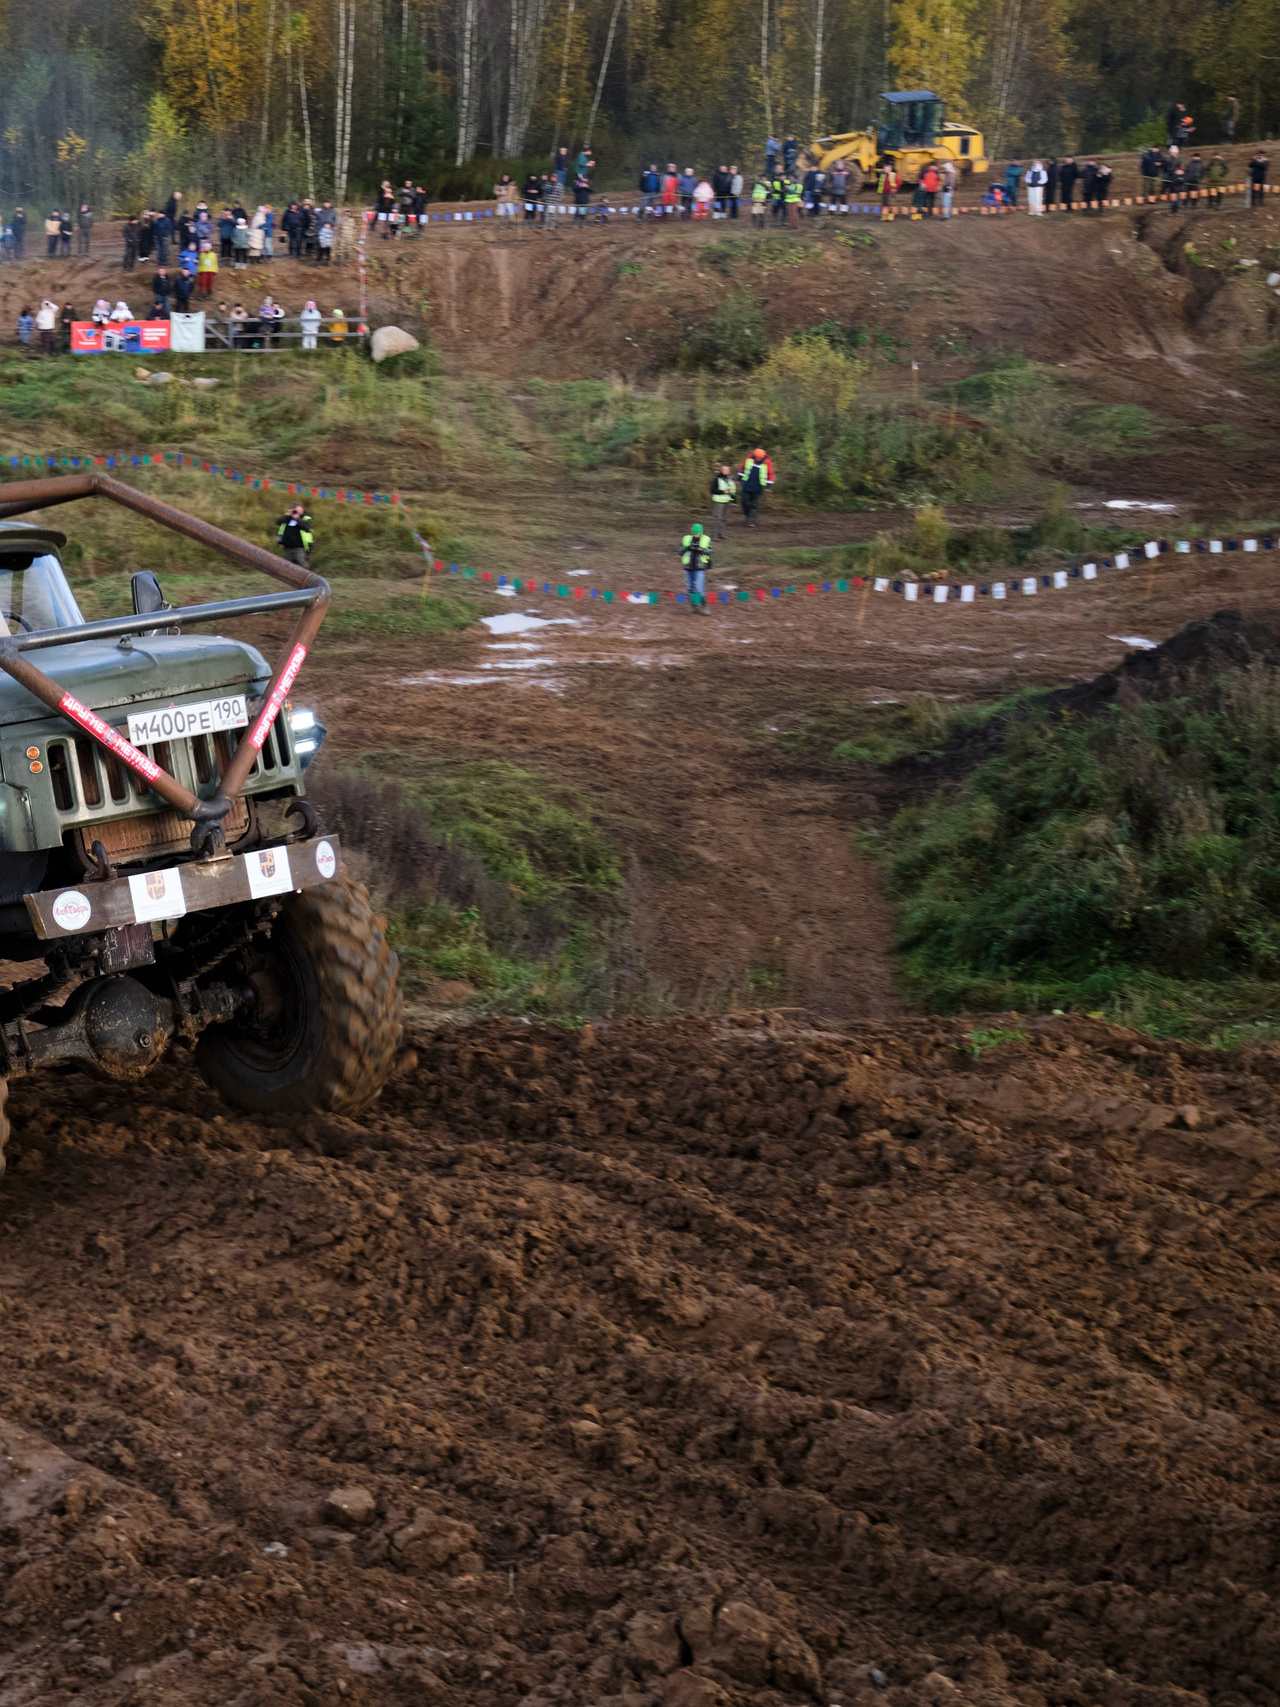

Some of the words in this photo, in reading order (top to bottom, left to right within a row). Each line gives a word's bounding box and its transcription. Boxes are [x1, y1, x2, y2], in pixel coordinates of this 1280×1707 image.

[135, 711, 211, 741] М400РЕ
[214, 700, 241, 720] 190
[222, 718, 236, 726] RUS
[253, 703, 278, 747] ДРУГИЕ
[279, 647, 307, 694] МЕТИЗЫ
[63, 698, 106, 734] ДРУГИЕ
[115, 738, 159, 777] МЕТИЗЫ
